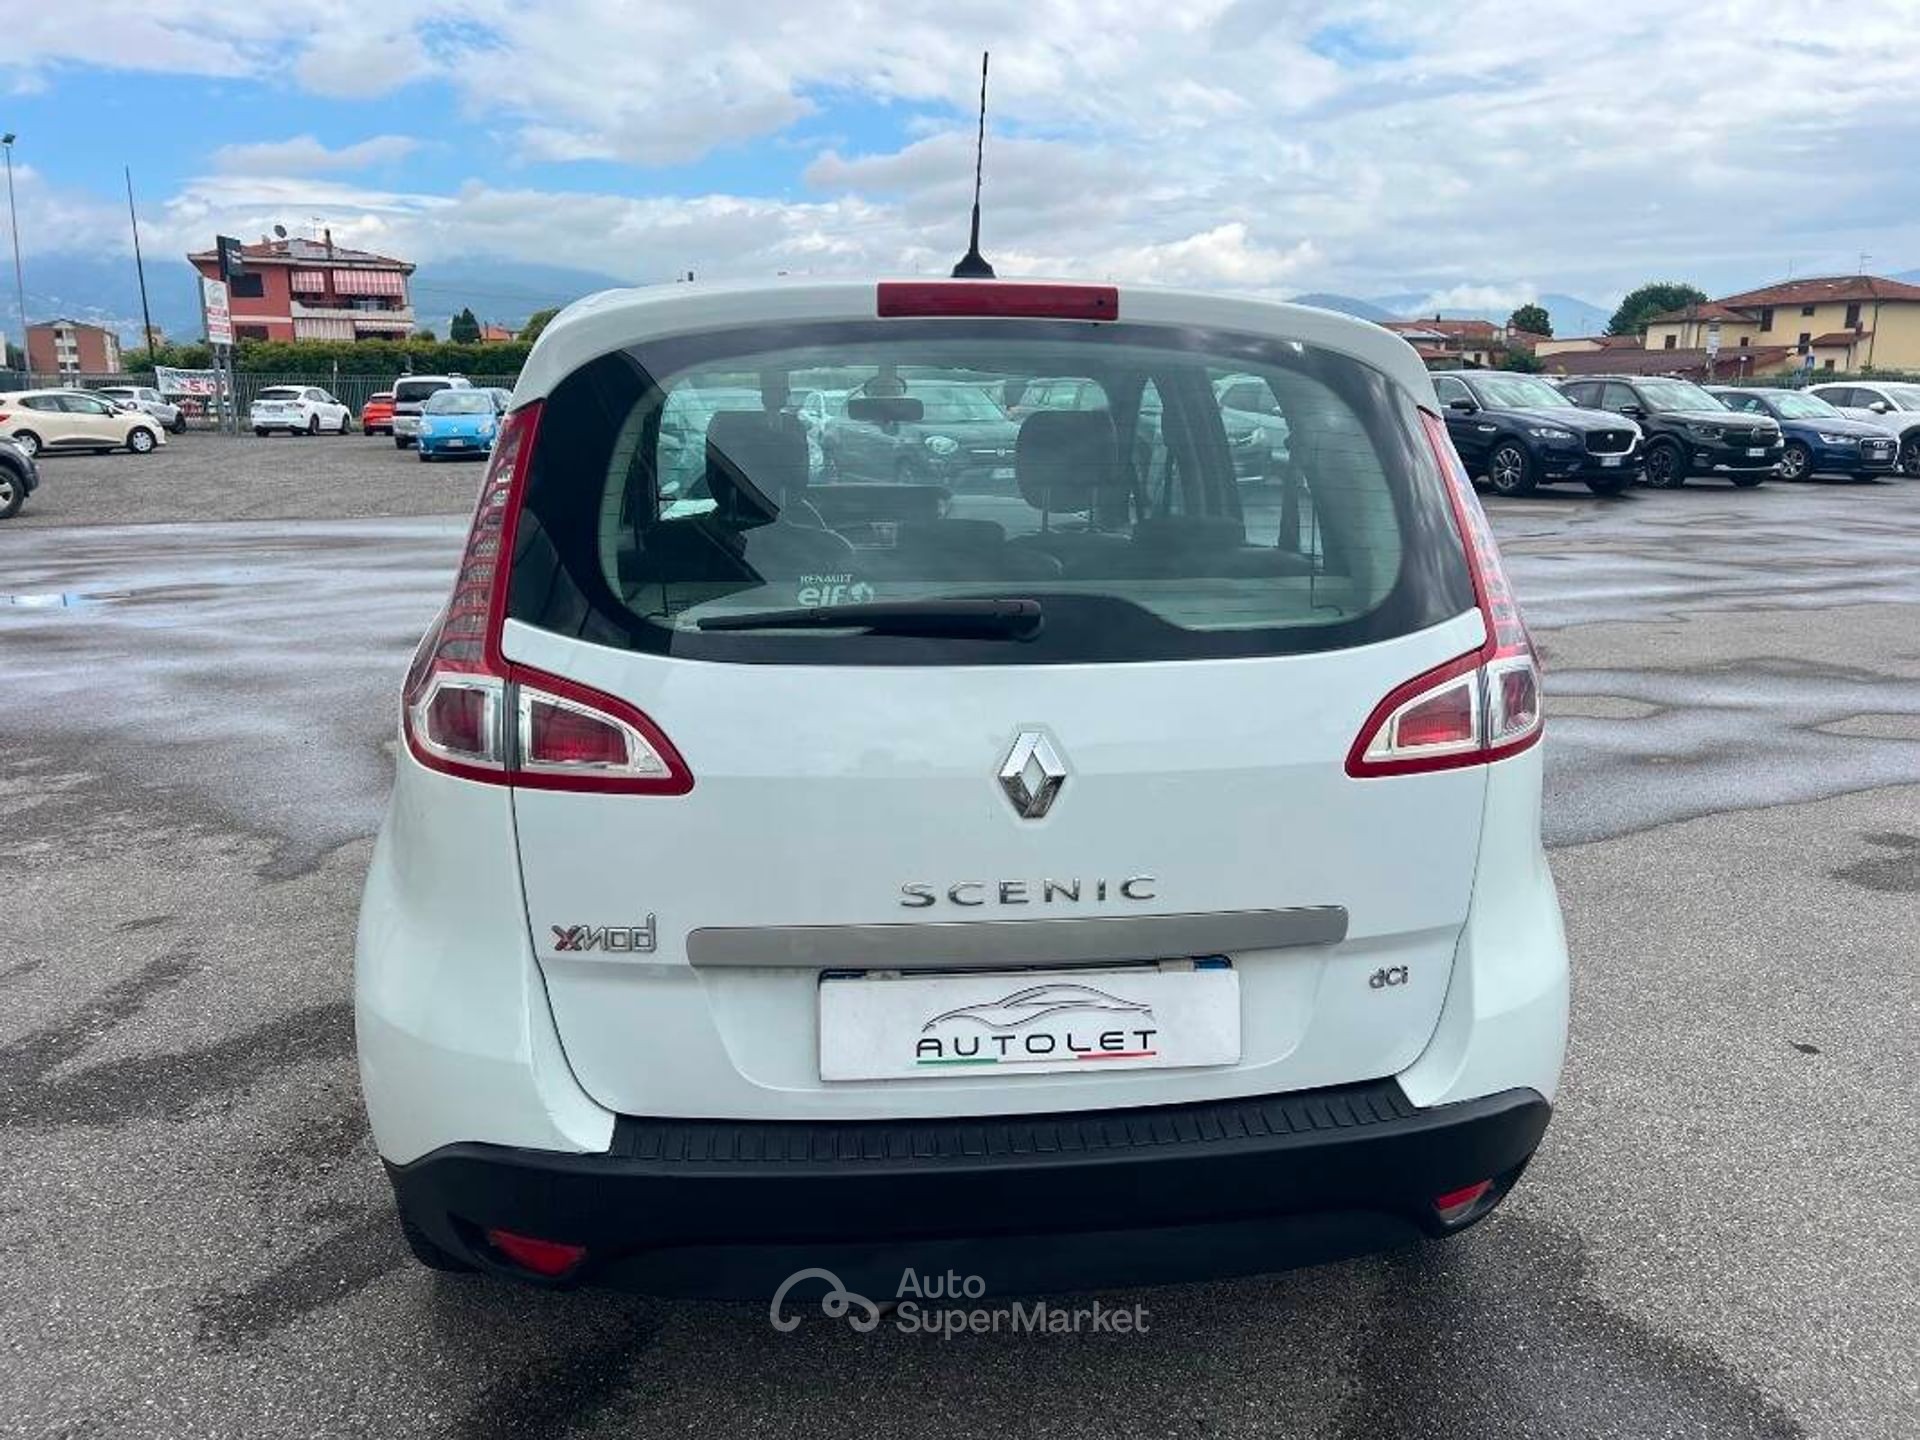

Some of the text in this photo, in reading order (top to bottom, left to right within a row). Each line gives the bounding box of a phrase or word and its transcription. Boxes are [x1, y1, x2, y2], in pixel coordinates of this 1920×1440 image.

[901, 877, 1156, 908] SCENIC
[1369, 966, 1408, 988] dCi
[916, 1030, 1157, 1057] AUTOLET
